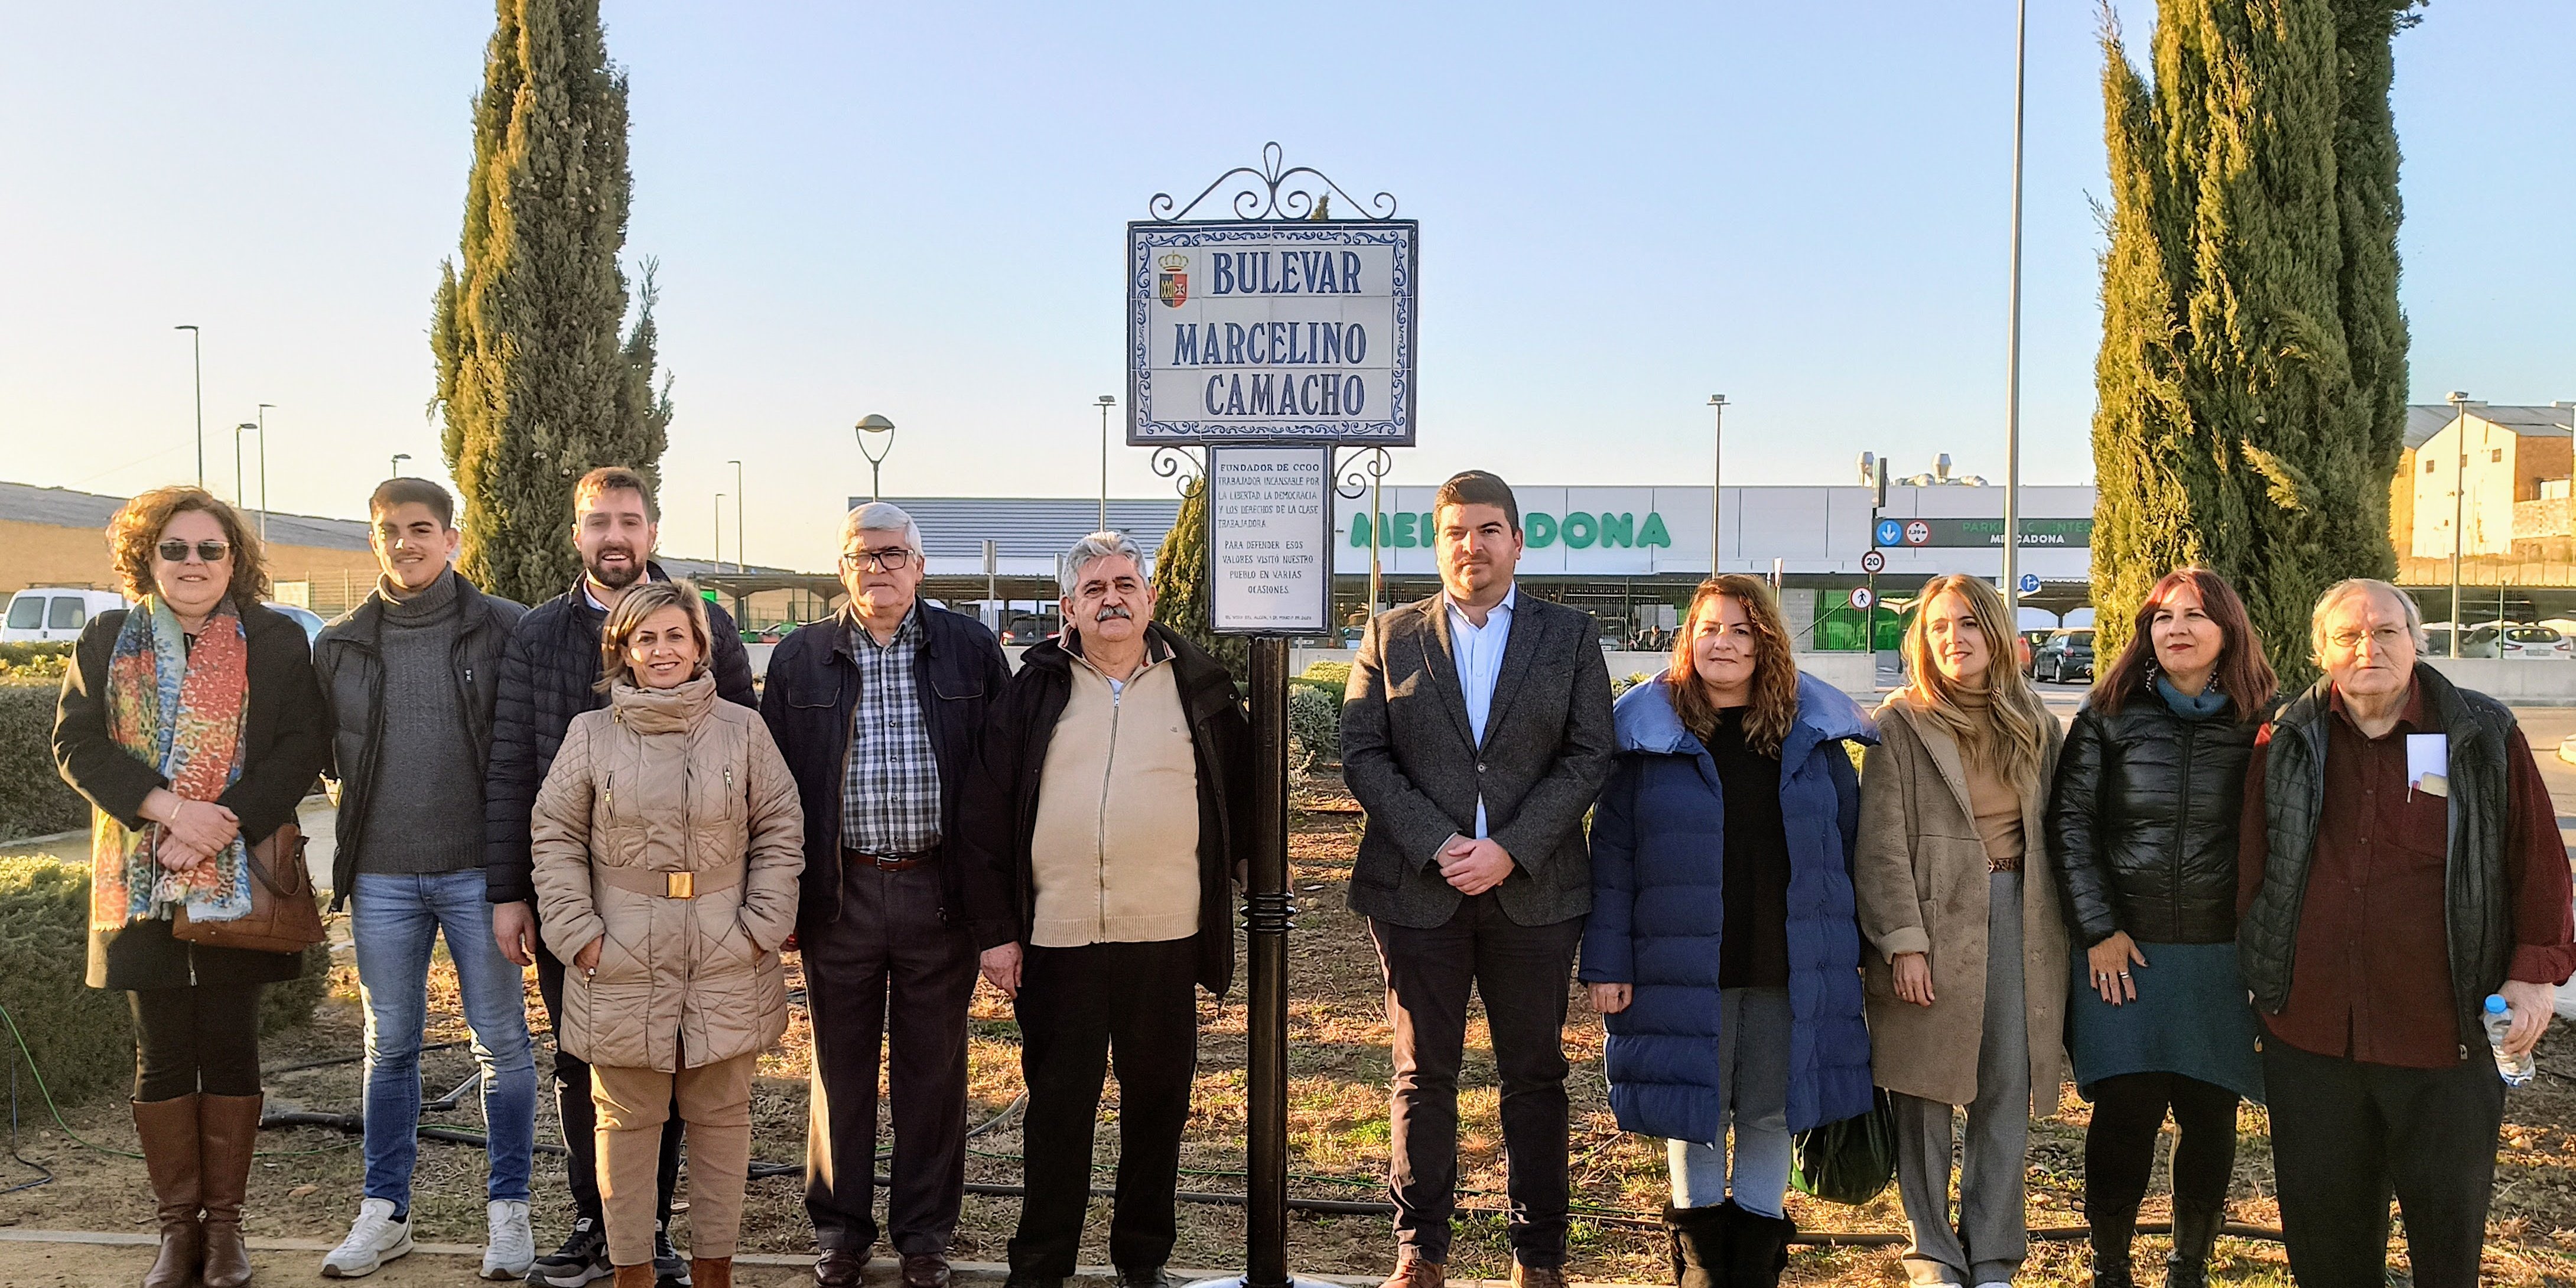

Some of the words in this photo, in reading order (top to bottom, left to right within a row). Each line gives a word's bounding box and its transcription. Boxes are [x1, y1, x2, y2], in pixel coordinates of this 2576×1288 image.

[1212, 251, 1361, 294] BULEVAR
[1172, 322, 1367, 365] MARCELINO
[1205, 373, 1365, 416] CAMACHO
[1218, 477, 1261, 486] TRABAJADOR
[1264, 477, 1304, 486] INCANSABLE
[1306, 477, 1319, 486] POR
[1218, 492, 1227, 500] LA
[1264, 492, 1272, 500] LA
[1274, 492, 1317, 500] DEMOCRACIA
[1218, 506, 1223, 514] Y
[1226, 506, 1238, 514] LOS
[1241, 506, 1273, 514] DERECHOS
[1276, 506, 1285, 514] DE
[1288, 506, 1296, 514] LA
[1298, 506, 1319, 514] CLASE
[1350, 512, 1671, 549] MEDONA
[1225, 540, 1243, 549] PARA
[1246, 540, 1280, 549] DEFENDER
[1286, 540, 1303, 549] ESOS
[1222, 555, 1253, 564] VALORES
[1283, 555, 1313, 564] NUESTRO
[1866, 557, 1879, 565] 20
